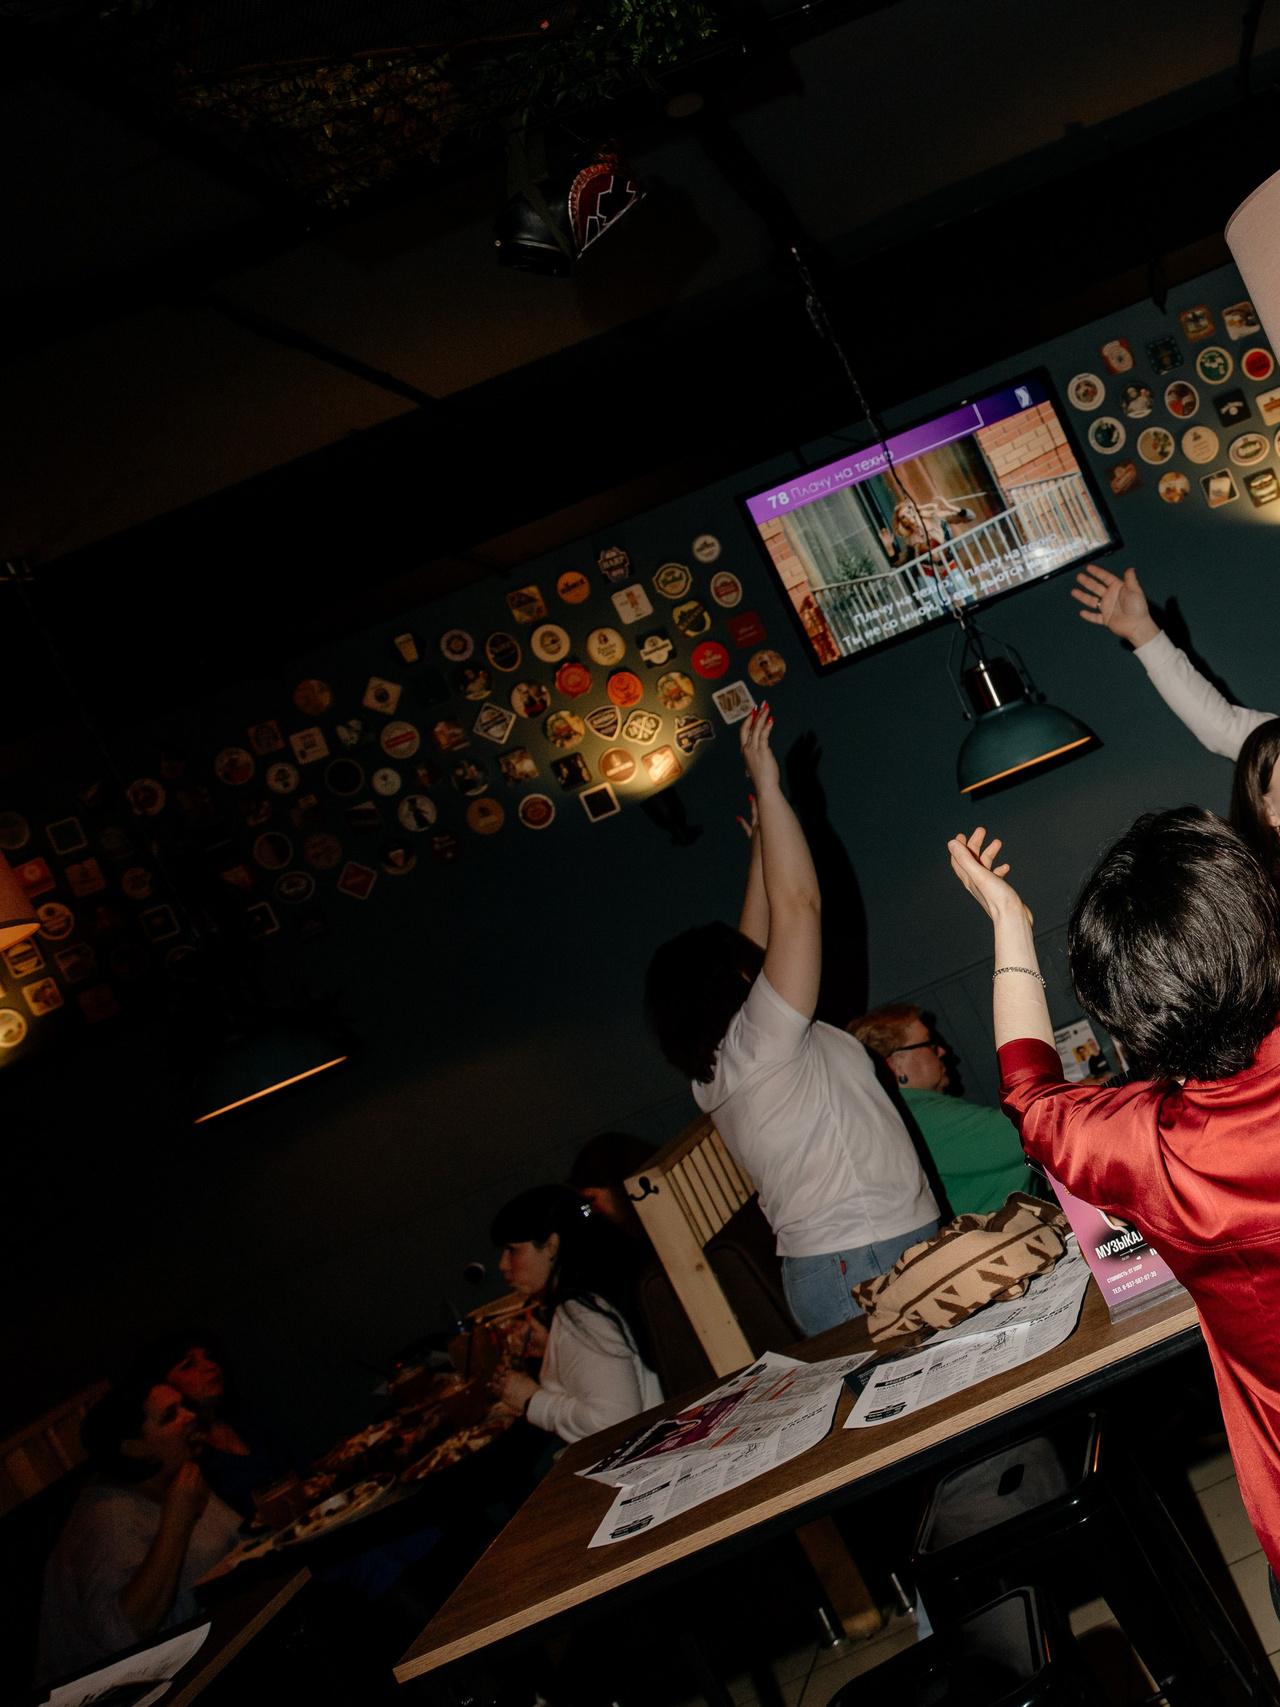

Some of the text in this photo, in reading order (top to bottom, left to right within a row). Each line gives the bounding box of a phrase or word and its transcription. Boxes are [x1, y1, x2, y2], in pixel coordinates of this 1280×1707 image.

[766, 450, 895, 509] 78 Плачу на техно
[853, 603, 894, 626] Плачу
[895, 595, 912, 609] на
[965, 556, 1002, 578] плачу
[1004, 549, 1021, 562] на
[842, 634, 864, 649] Ты
[864, 626, 882, 640] не
[883, 619, 899, 631] со
